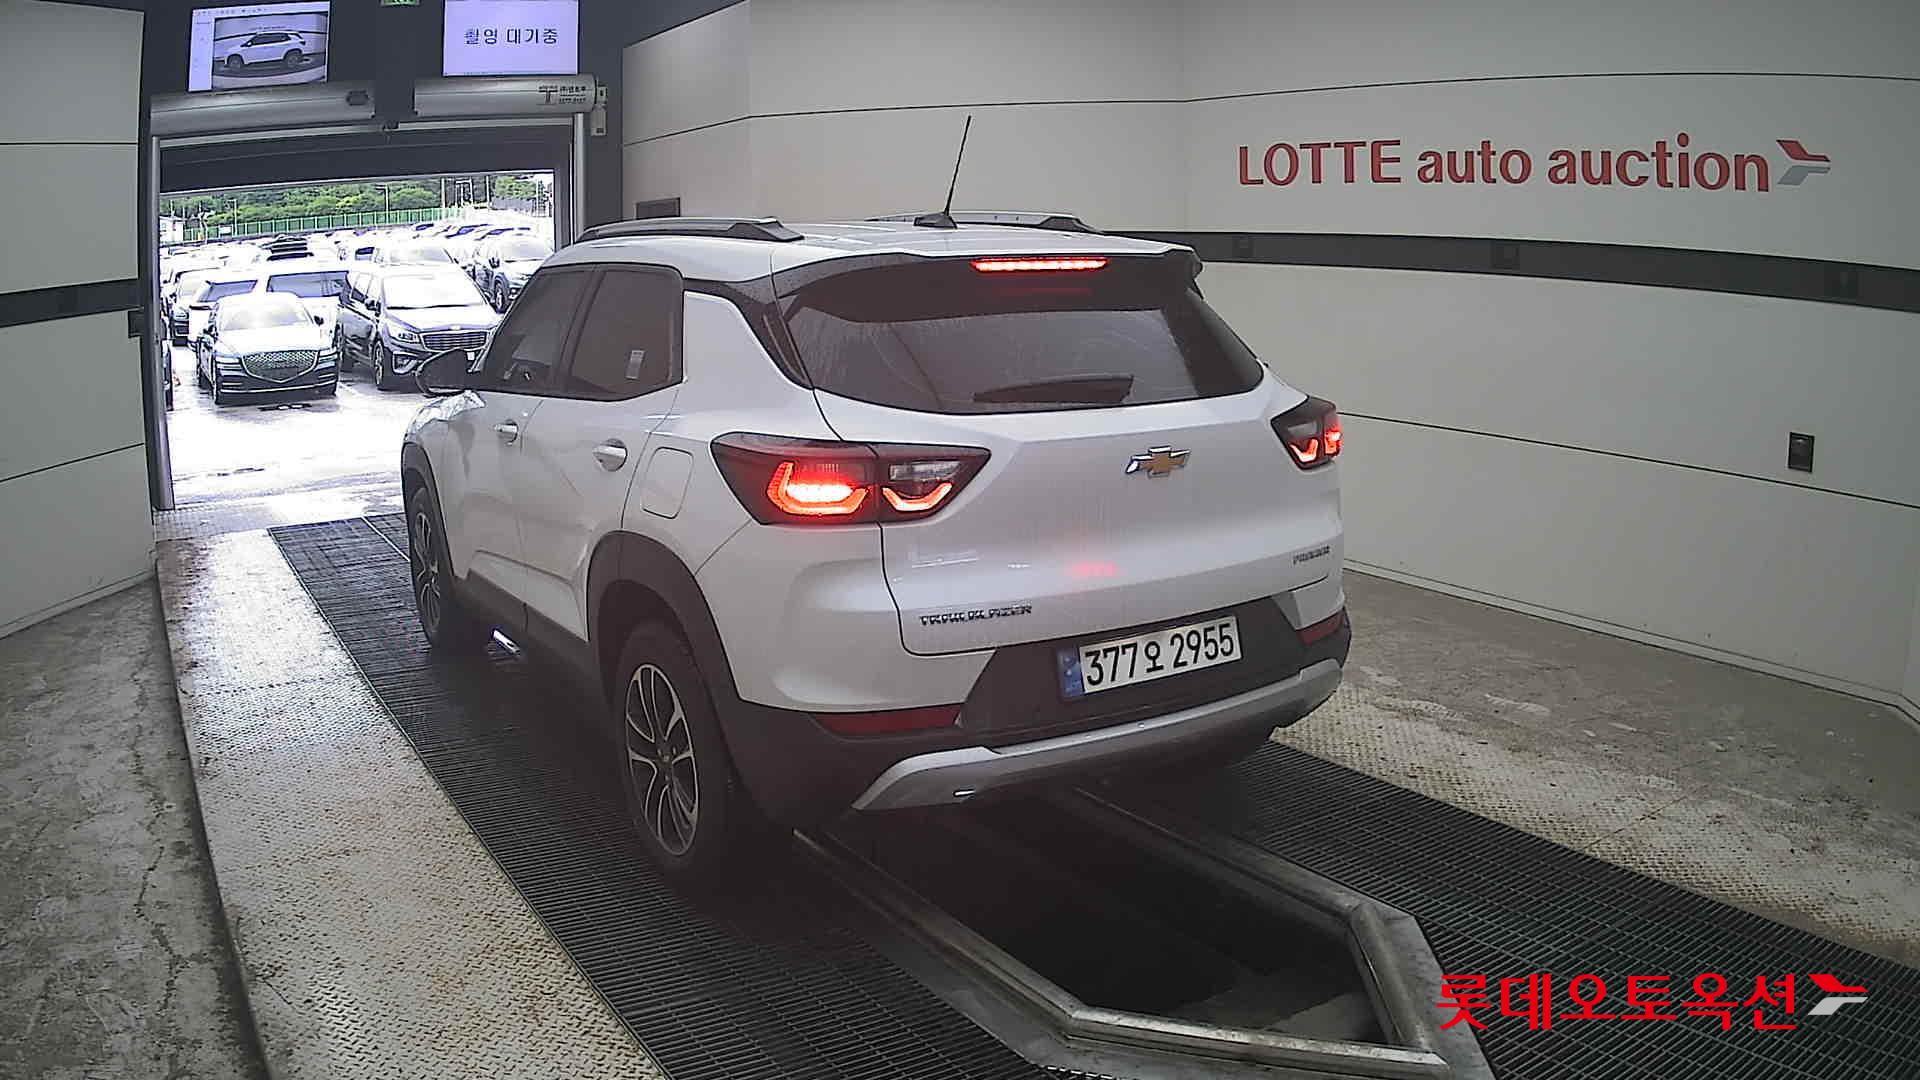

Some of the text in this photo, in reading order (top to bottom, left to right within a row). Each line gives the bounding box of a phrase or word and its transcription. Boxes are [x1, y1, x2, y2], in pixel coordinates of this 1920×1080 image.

[506, 28, 558, 44] 대기중
[1240, 133, 1769, 192] LOTTE auto auction
[1085, 623, 1234, 686] 377오 2955
